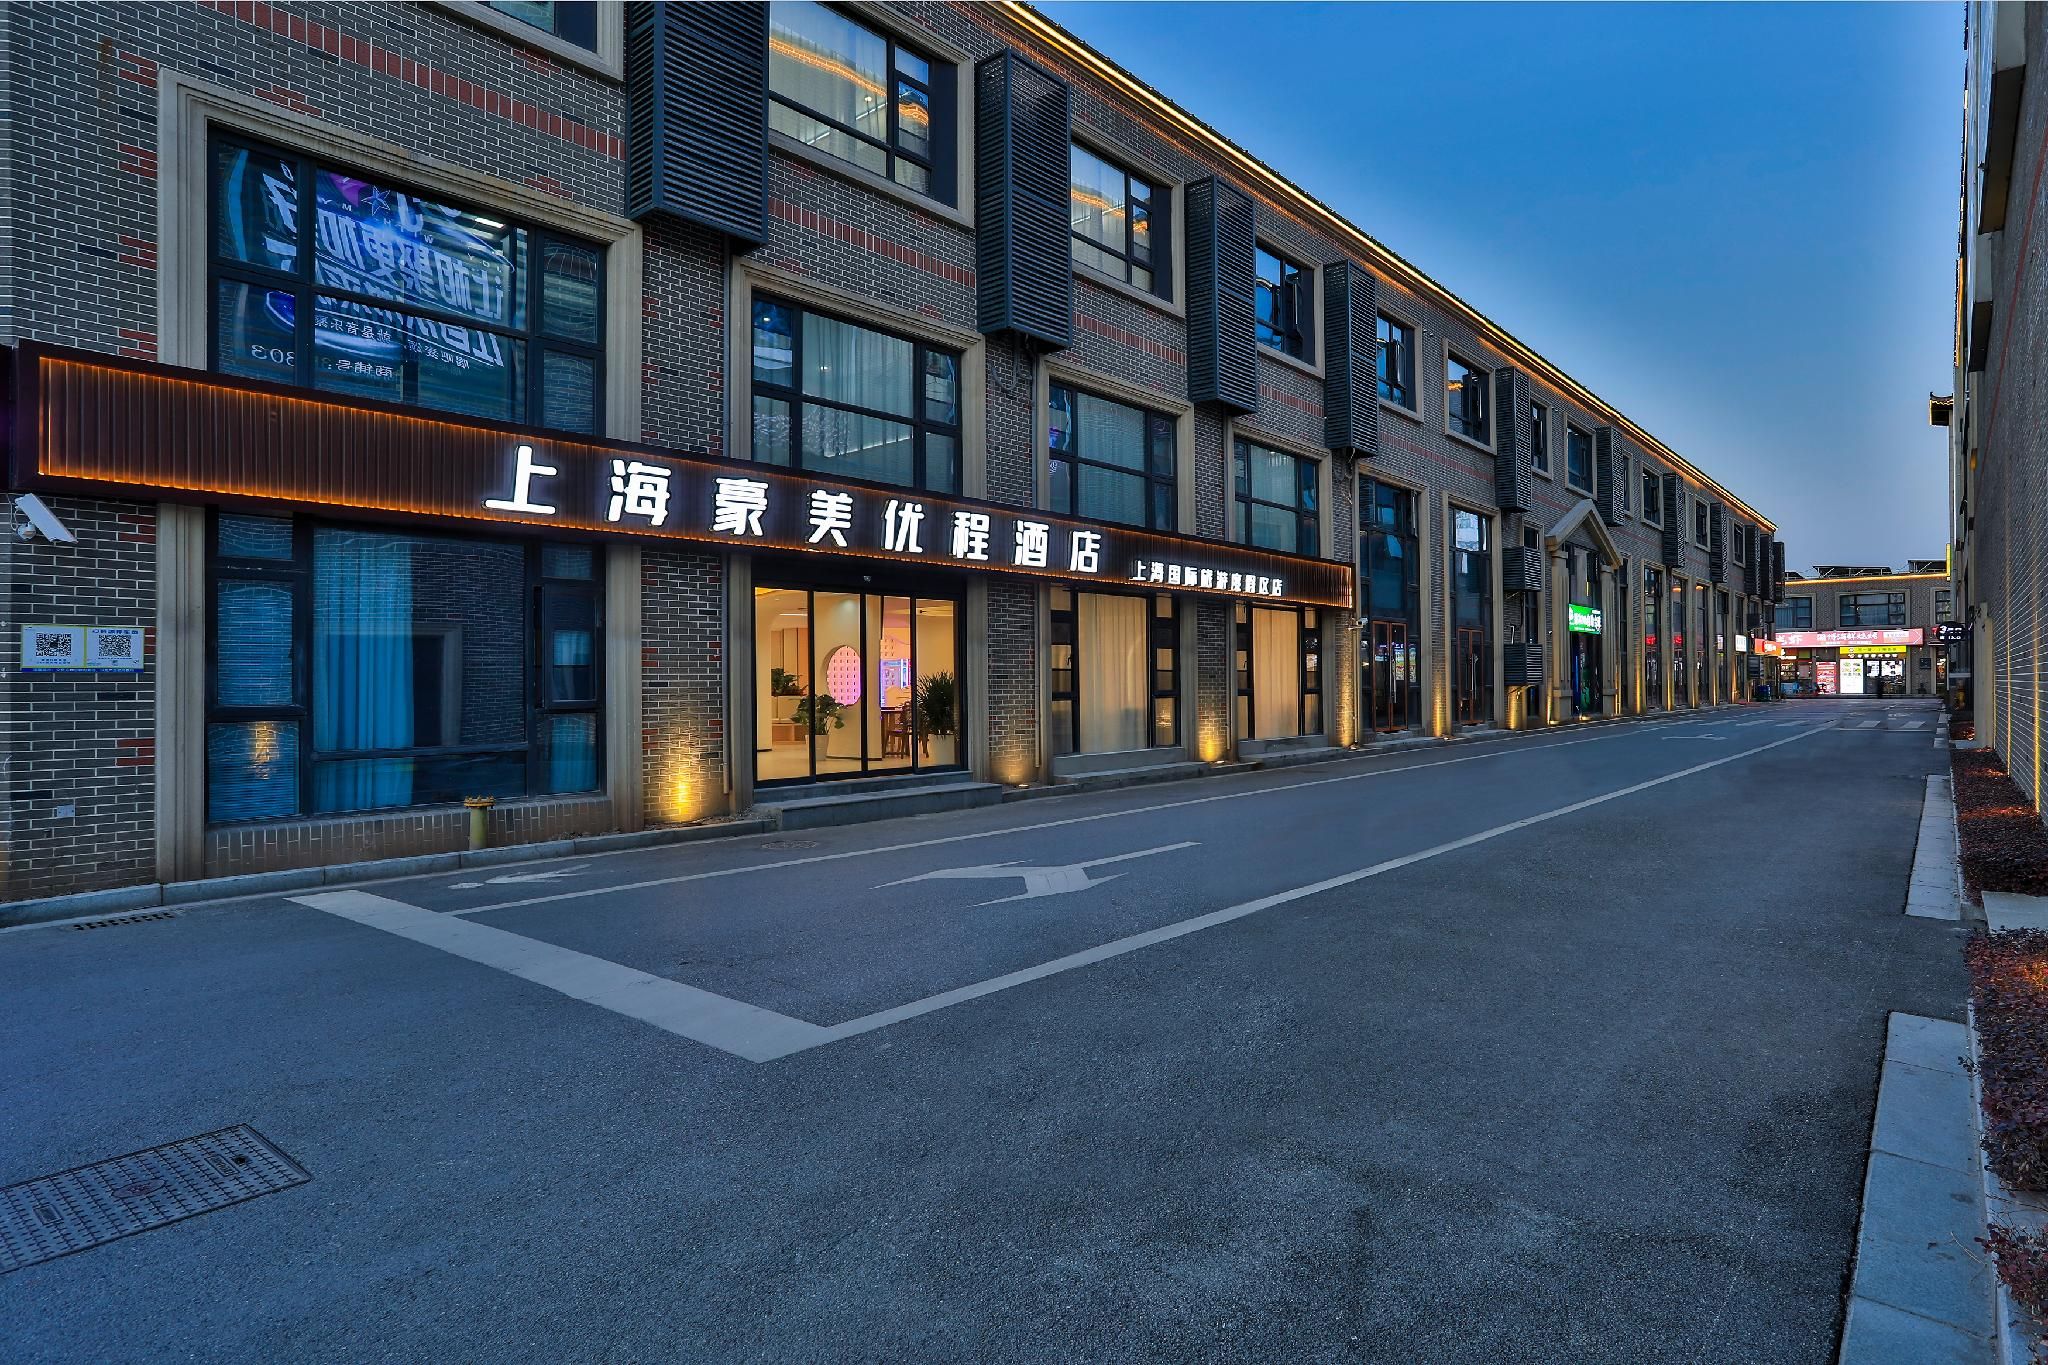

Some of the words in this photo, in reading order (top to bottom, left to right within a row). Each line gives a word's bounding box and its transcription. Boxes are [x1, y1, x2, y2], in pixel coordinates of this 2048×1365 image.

[484, 445, 1102, 574] 上海豪美优程酒店
[1129, 560, 1283, 597] 上海国际旅游度假区店
